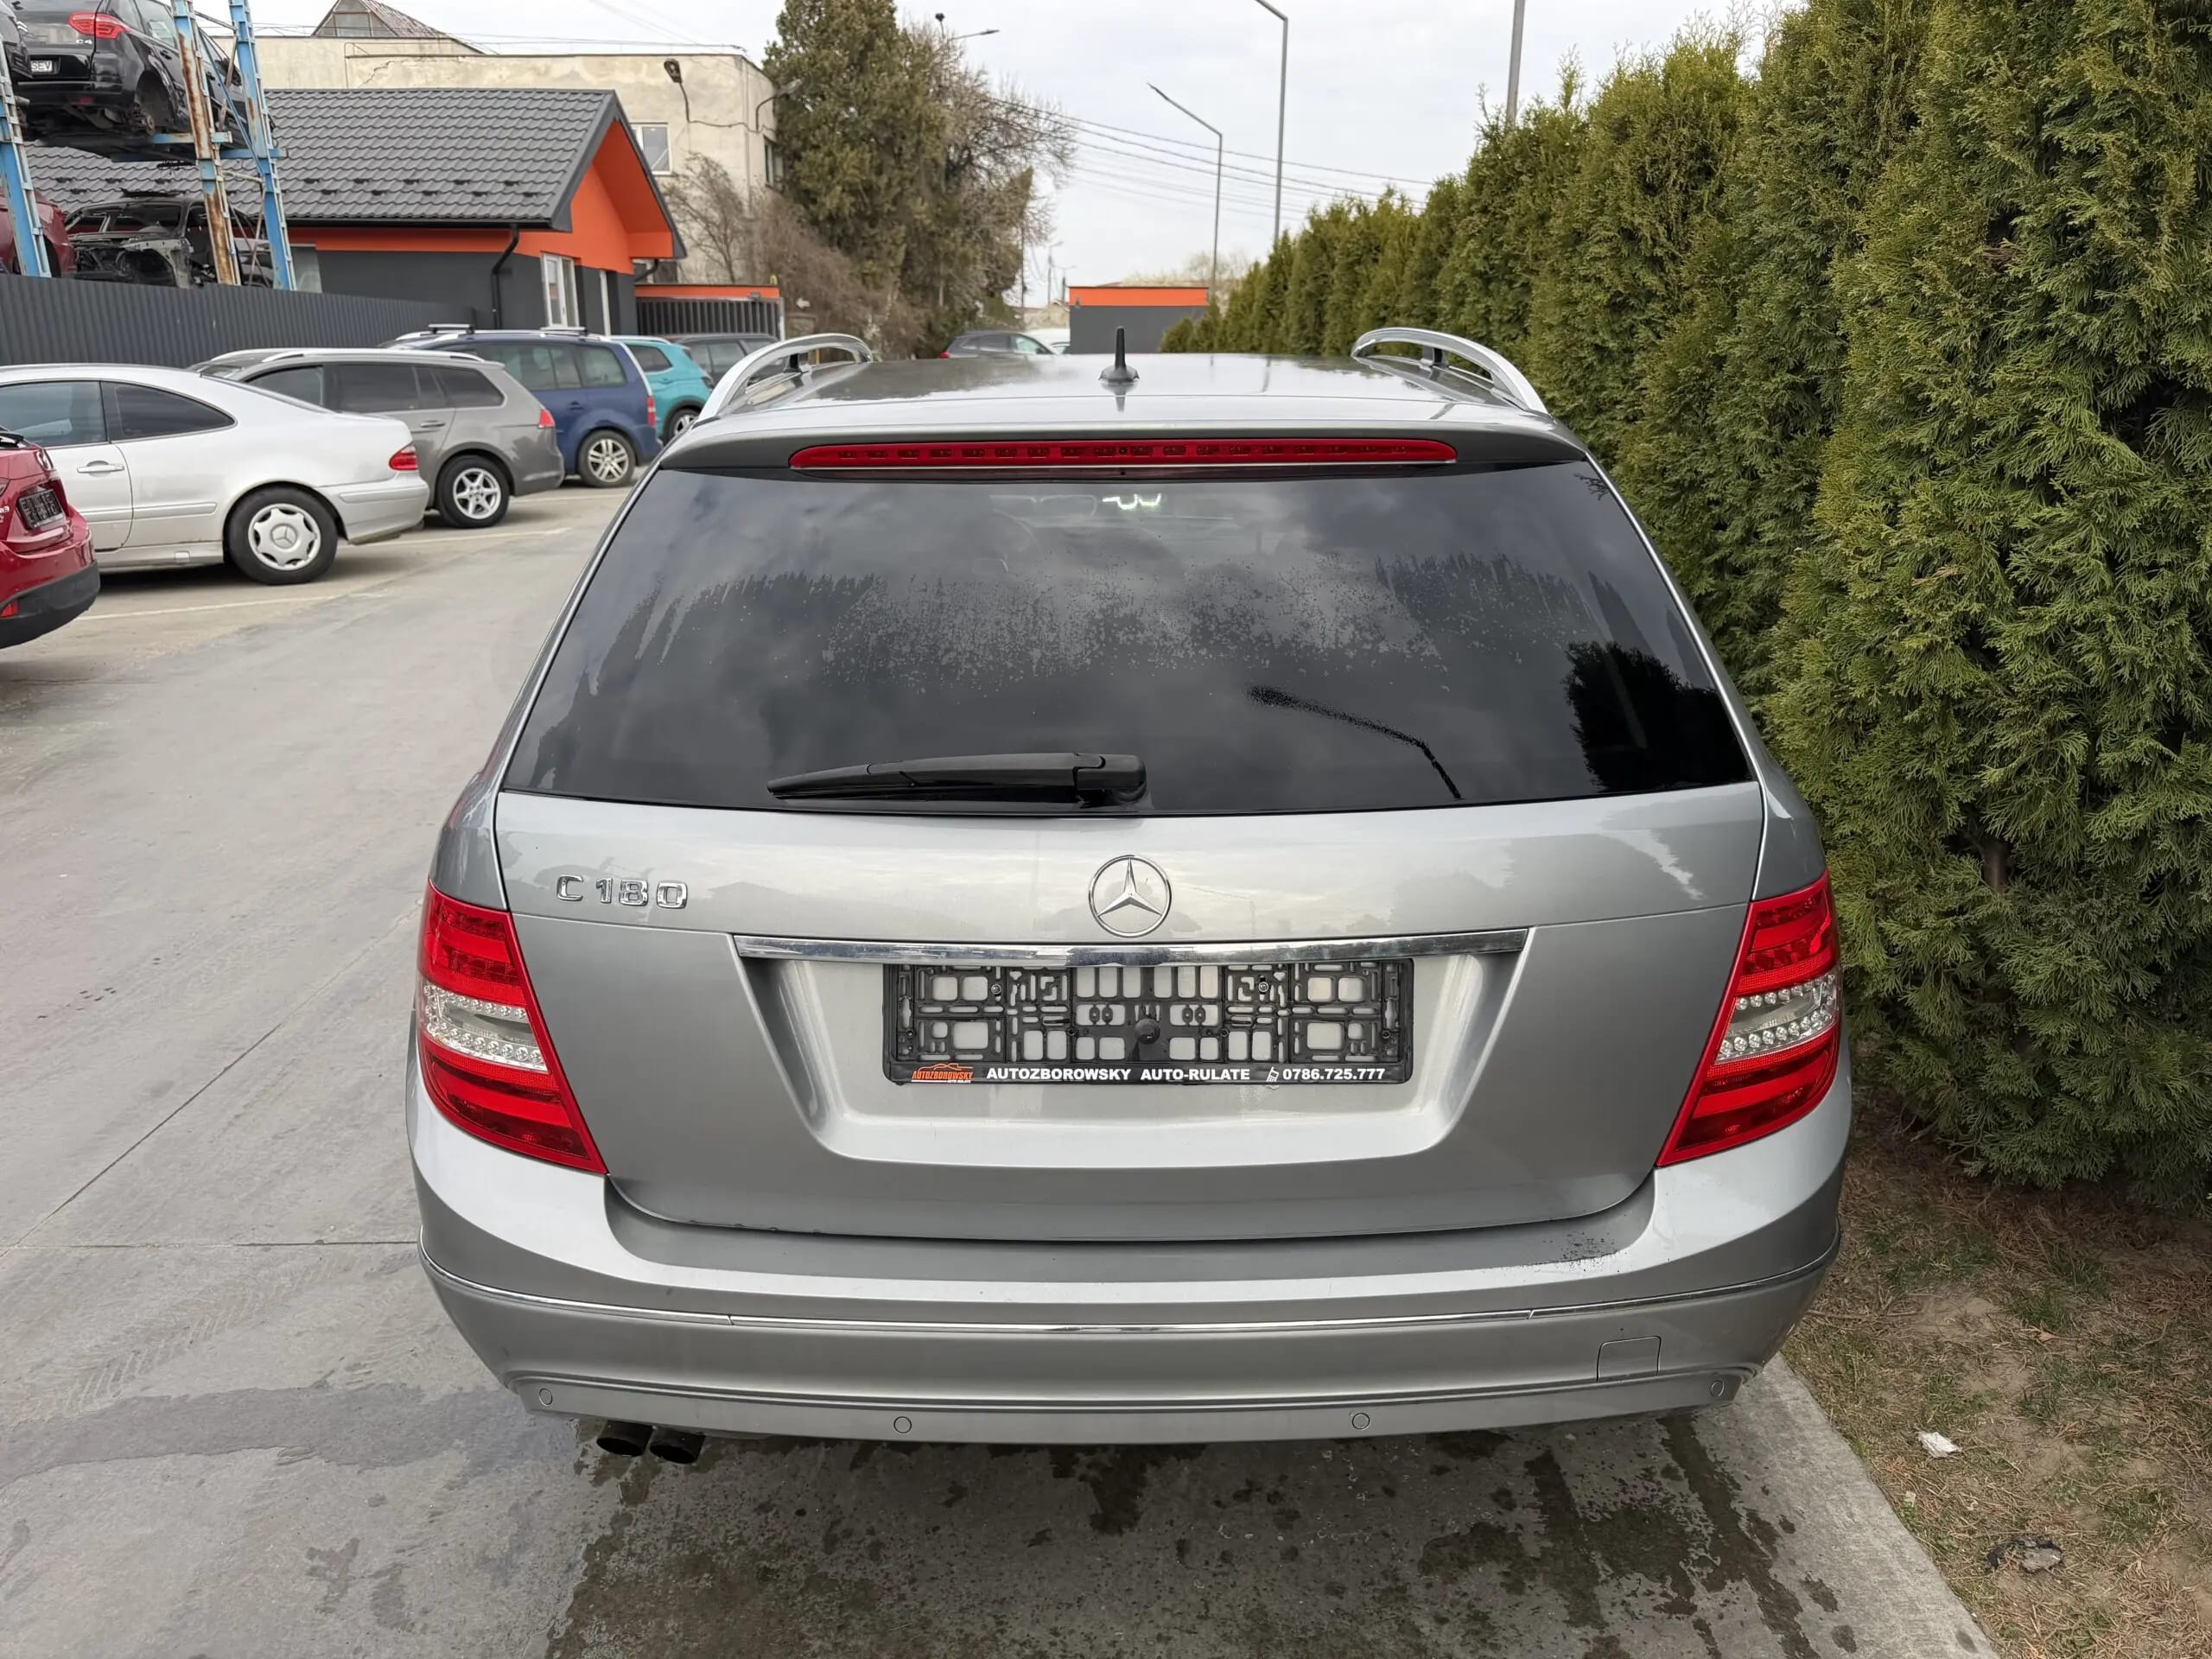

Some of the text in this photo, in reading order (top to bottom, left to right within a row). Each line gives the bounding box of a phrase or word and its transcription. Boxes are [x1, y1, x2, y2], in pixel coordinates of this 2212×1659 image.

[31, 61, 52, 70] SEV
[556, 874, 689, 909] C 180
[986, 1067, 1386, 1081] AUTOZBOROWSKY AUTO-RULATE 0786.725.777
